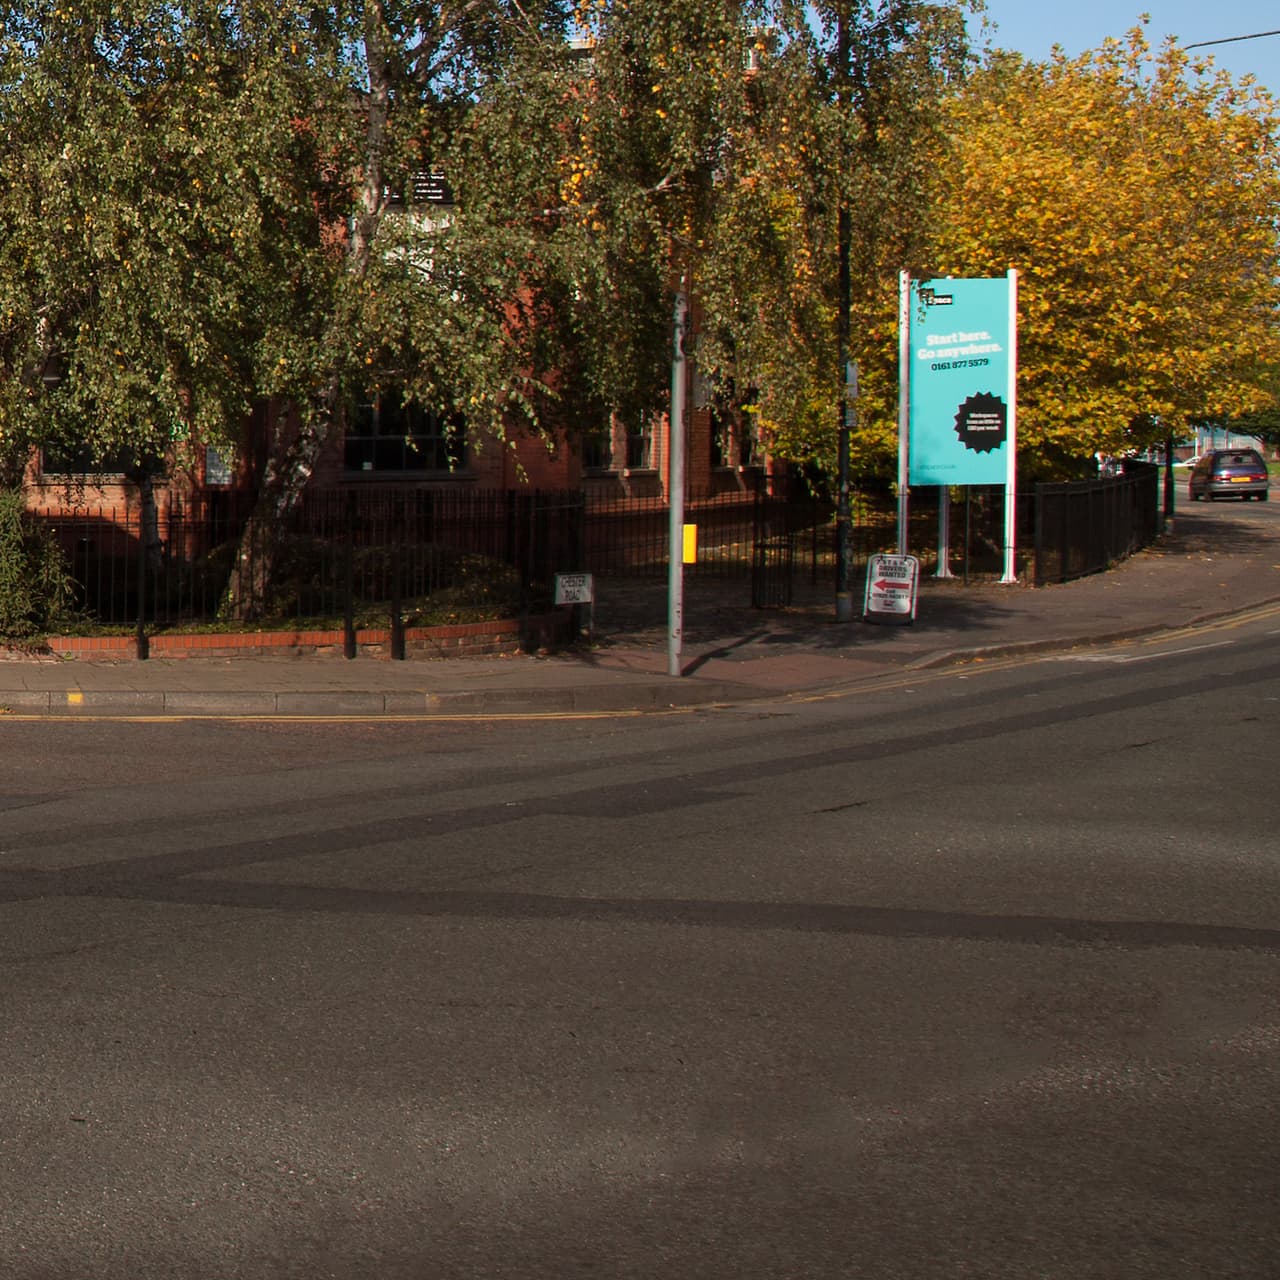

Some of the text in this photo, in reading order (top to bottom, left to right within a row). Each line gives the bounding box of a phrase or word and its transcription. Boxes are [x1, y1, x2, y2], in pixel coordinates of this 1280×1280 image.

[926, 330, 992, 346] Start here.
[917, 342, 1003, 360] Go anywhere.
[931, 358, 989, 371] 0161 877 5579
